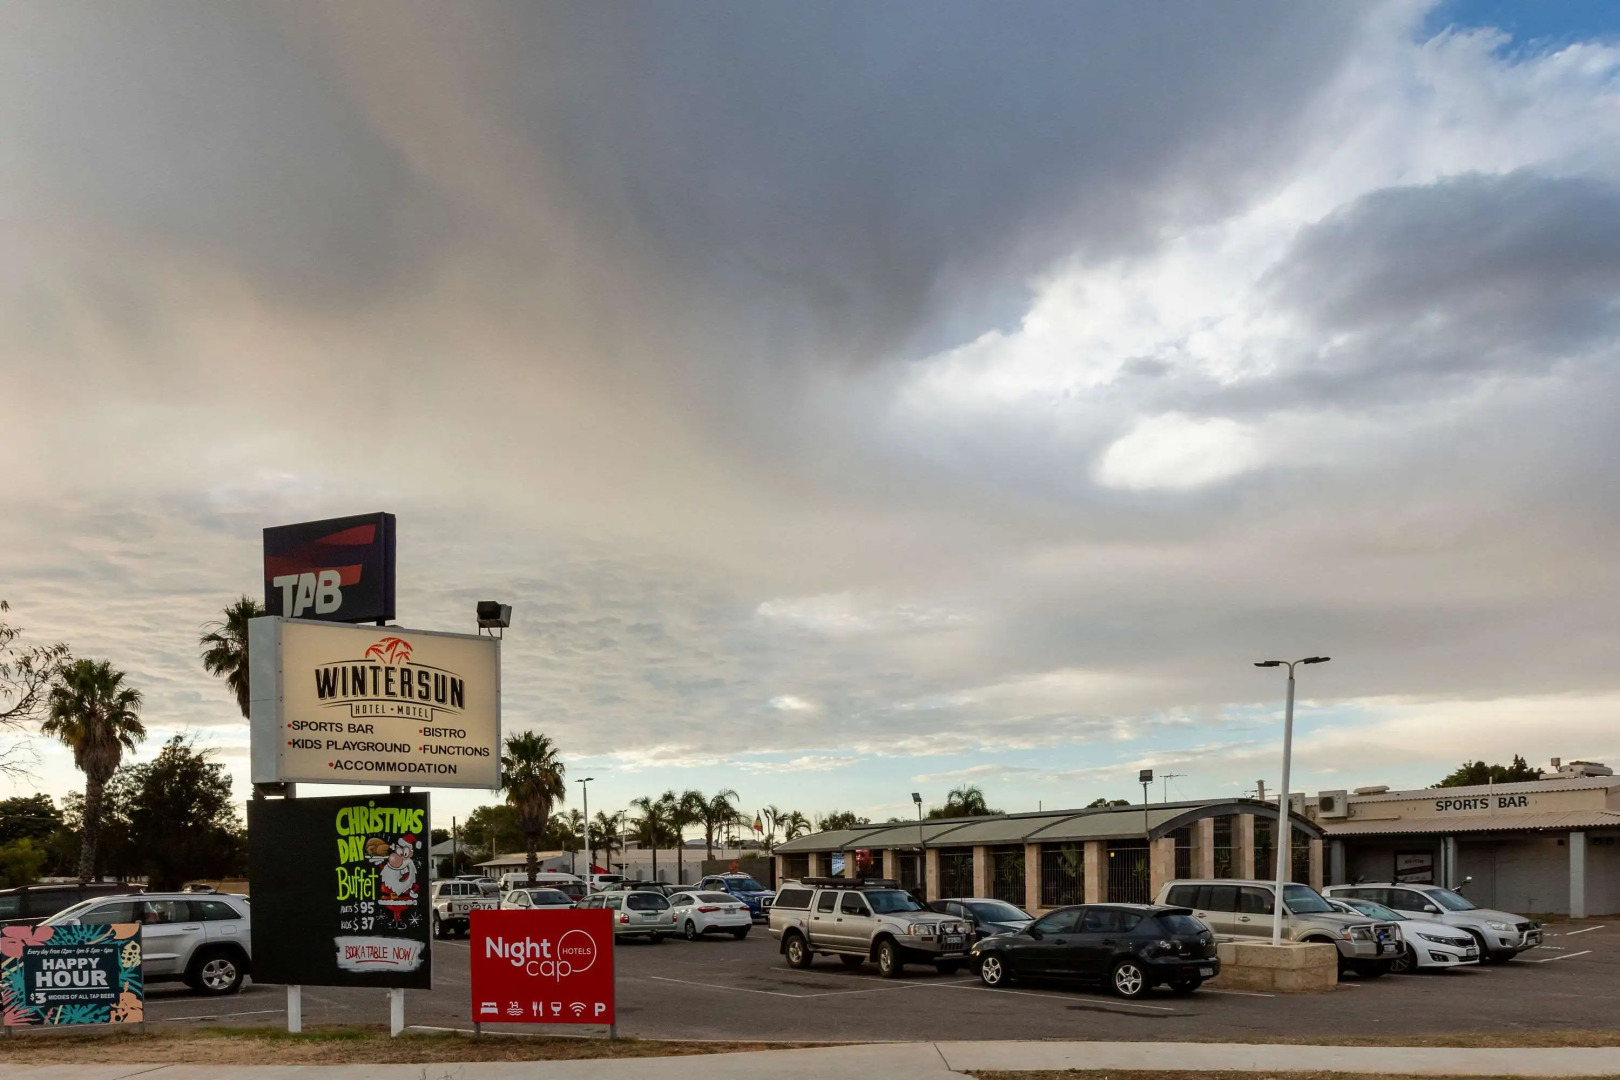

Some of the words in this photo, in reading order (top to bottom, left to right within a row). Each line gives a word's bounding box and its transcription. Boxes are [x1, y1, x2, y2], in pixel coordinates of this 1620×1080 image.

[273, 569, 343, 618] TAB
[314, 665, 466, 710] WINTERSUN
[355, 705, 386, 715] HOTEL
[397, 706, 429, 718] MOTEL
[292, 720, 343, 732] SPORTS
[347, 723, 374, 734] BAR
[423, 727, 467, 739] BISTRO
[292, 738, 322, 749] KIDS
[326, 740, 411, 753] PLAYGROUND
[423, 745, 490, 757] FUNCTIONS
[334, 760, 457, 774] ACCOMMODATION
[1435, 798, 1489, 811] SPORTS
[1498, 796, 1528, 808] BAR
[336, 800, 425, 836] CHRISTMAS
[337, 835, 366, 865] DAY
[336, 866, 379, 901] Buffet
[345, 945, 361, 960] BOOK
[366, 946, 388, 960] TABLE
[485, 936, 552, 967] Night
[562, 947, 592, 955] HOTELS
[42, 957, 100, 970] HAPPY
[35, 970, 108, 987] HOUR
[526, 960, 572, 983] cap
